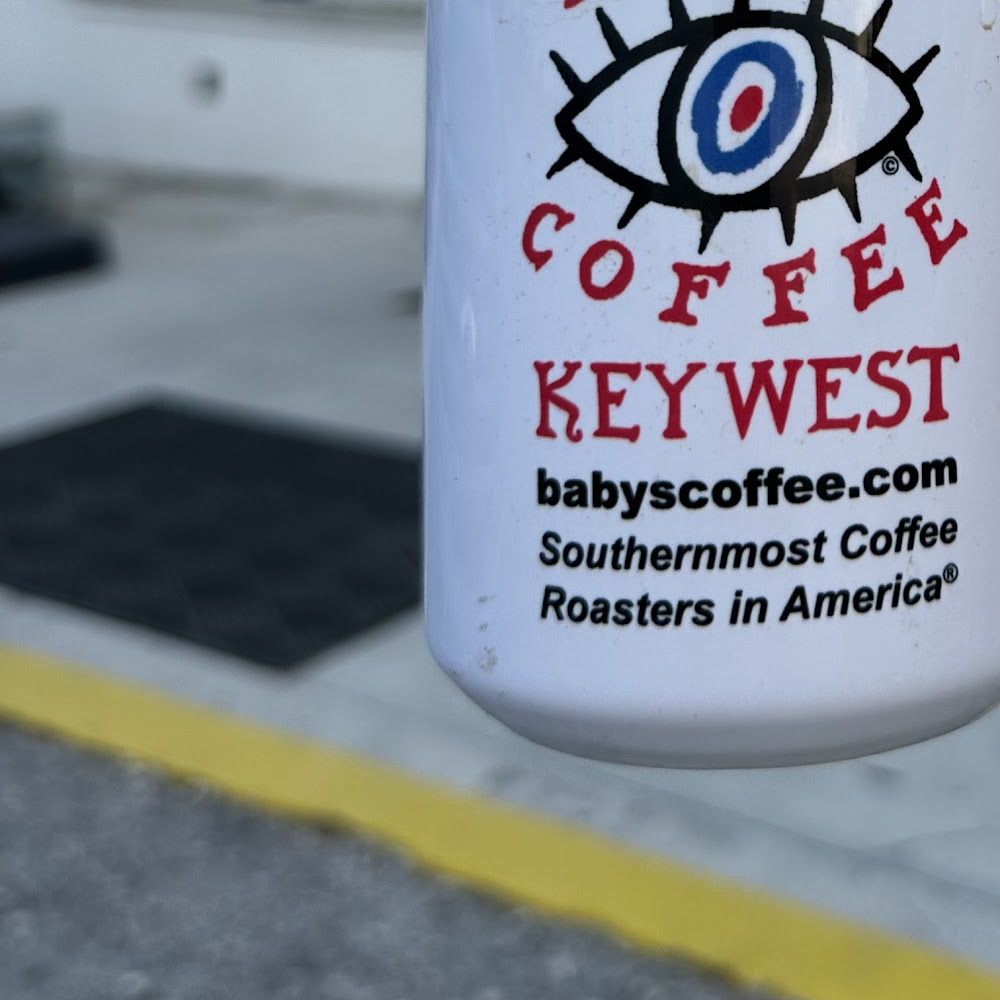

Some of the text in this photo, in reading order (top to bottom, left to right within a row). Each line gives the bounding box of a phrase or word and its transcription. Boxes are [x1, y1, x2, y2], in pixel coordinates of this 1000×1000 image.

[522, 178, 968, 327] COFFEE
[537, 456, 958, 519] babyscoffee.com
[539, 515, 958, 571] Southernmost Coffee
[541, 585, 715, 627] Roasters
[729, 590, 769, 625] in
